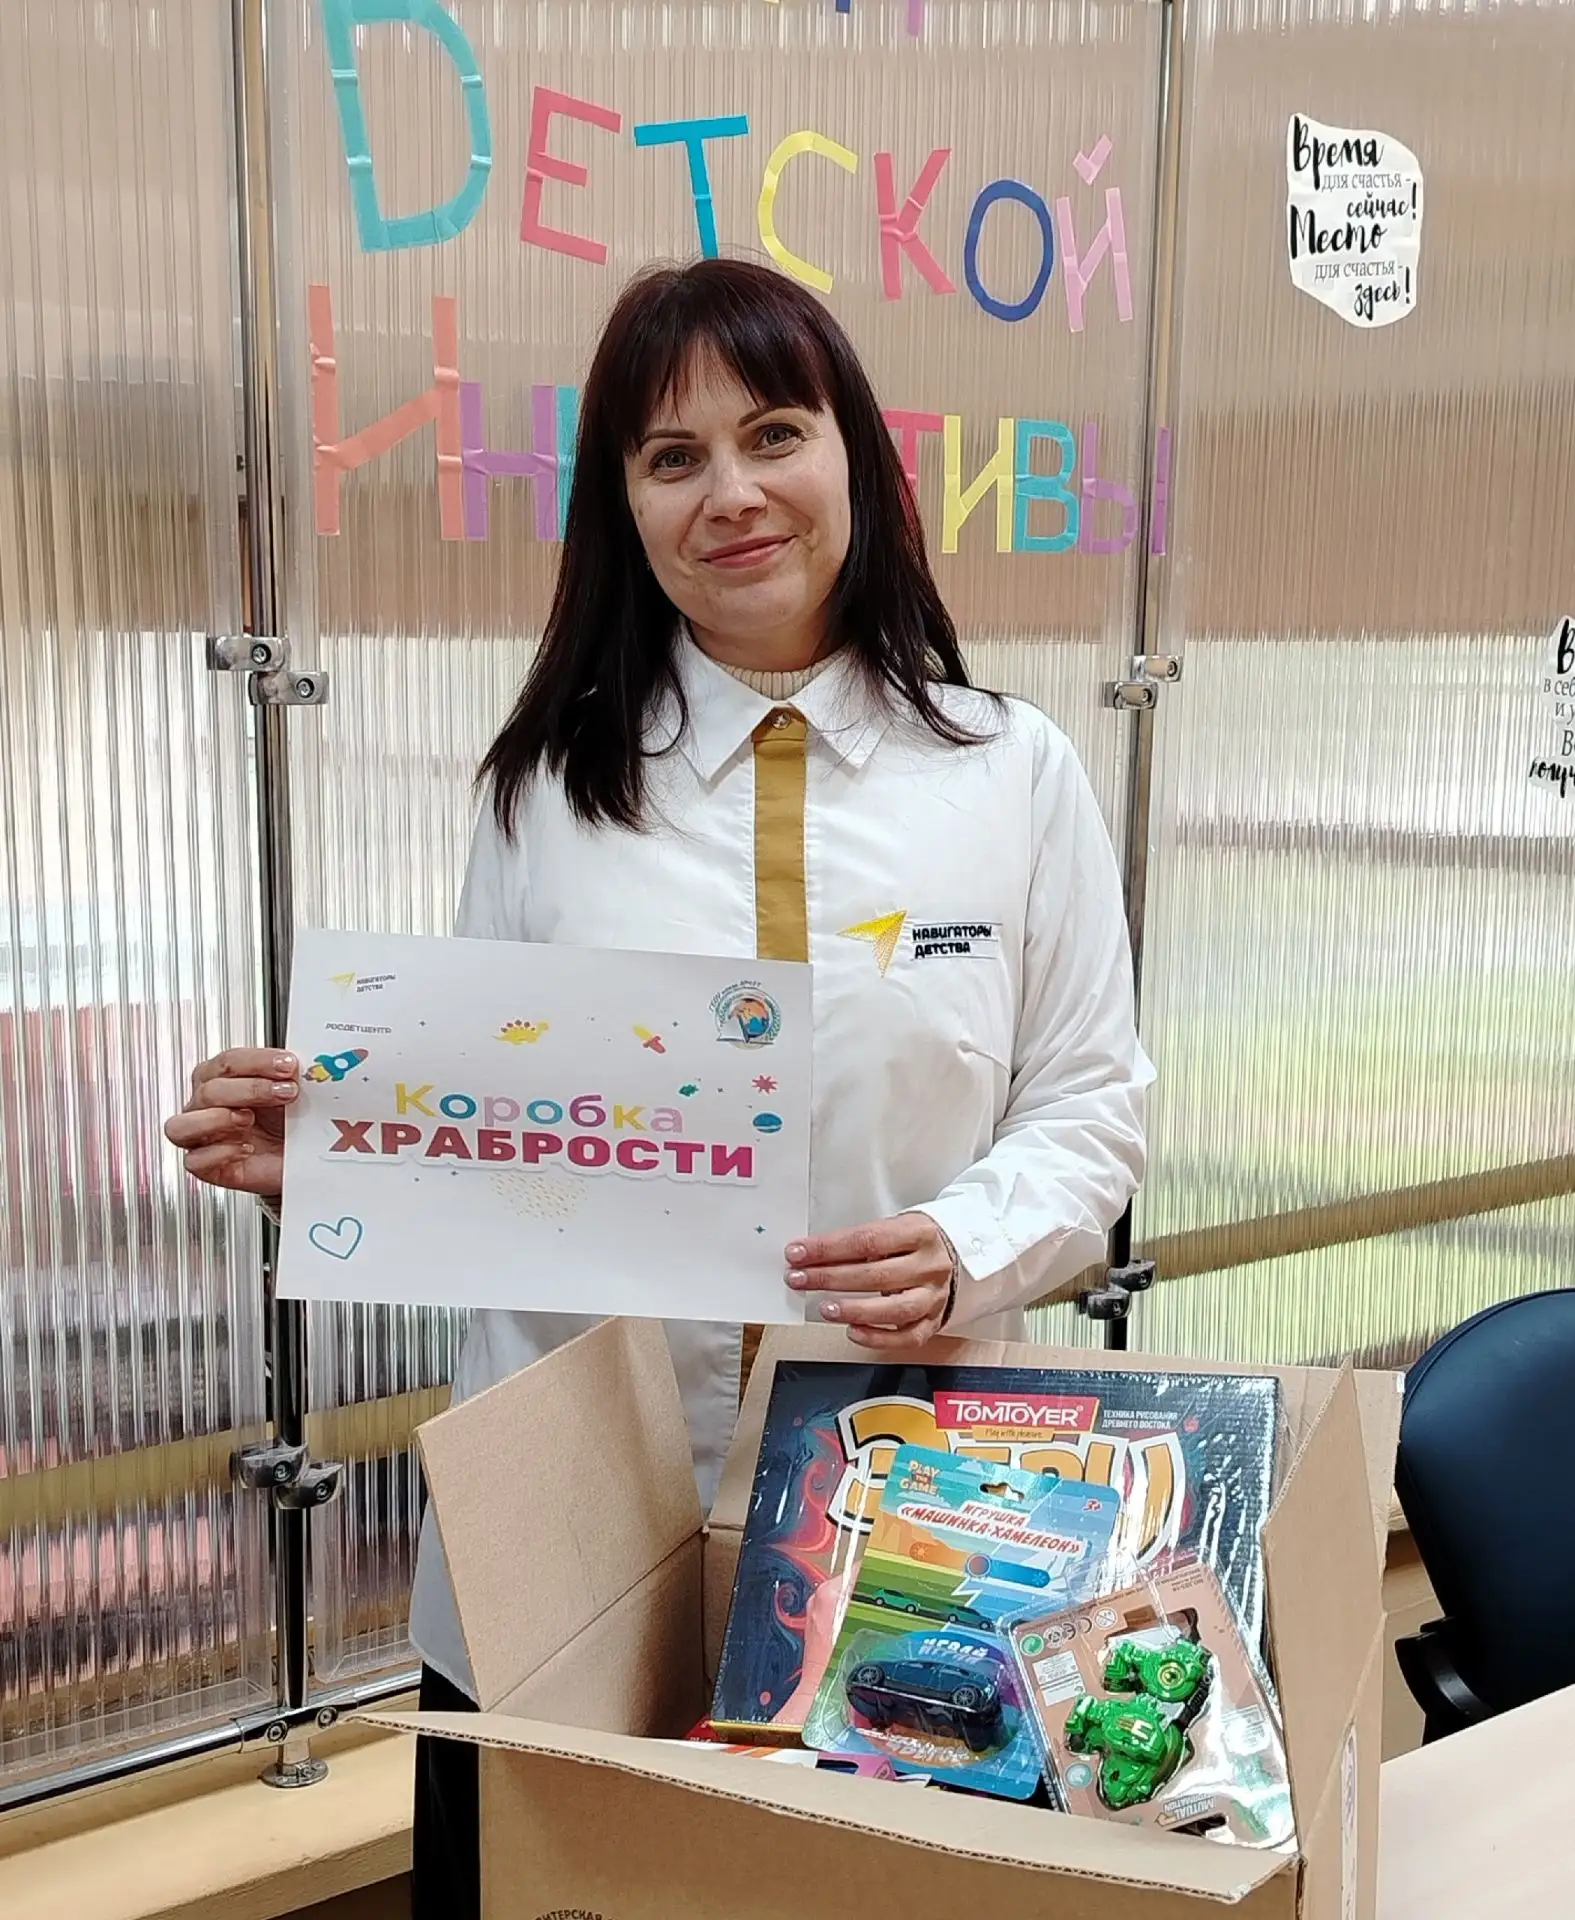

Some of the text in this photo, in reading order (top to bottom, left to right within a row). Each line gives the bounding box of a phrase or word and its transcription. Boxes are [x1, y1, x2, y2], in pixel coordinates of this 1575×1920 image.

[1293, 115, 1385, 191] Время
[1321, 174, 1348, 192] для
[1352, 172, 1402, 189] счастья
[1346, 182, 1418, 220] сейчас!
[1290, 204, 1388, 260] Место
[1314, 264, 1340, 282] для
[1344, 260, 1396, 278] счастья
[1354, 266, 1411, 322] здесь!
[912, 925, 992, 941] НАВИГАТОРЫ
[914, 942, 971, 960] ДЕТСТВА
[325, 1022, 392, 1034] РОСДЕТЦЕНТР
[395, 1082, 683, 1134] Коробка
[328, 1119, 754, 1178] ХРАБРОСТИ
[1102, 1419, 1172, 1430] ДРЕВНЕГО ВОСТОКА
[1103, 1409, 1178, 1420] ТЕХНИКА РИСОВАНИЯ
[908, 1460, 941, 1477] PLAY
[900, 1478, 938, 1496] GAME
[961, 1503, 1026, 1528] ИГРУШКА
[1175, 1796, 1217, 1821] MUTUAL
